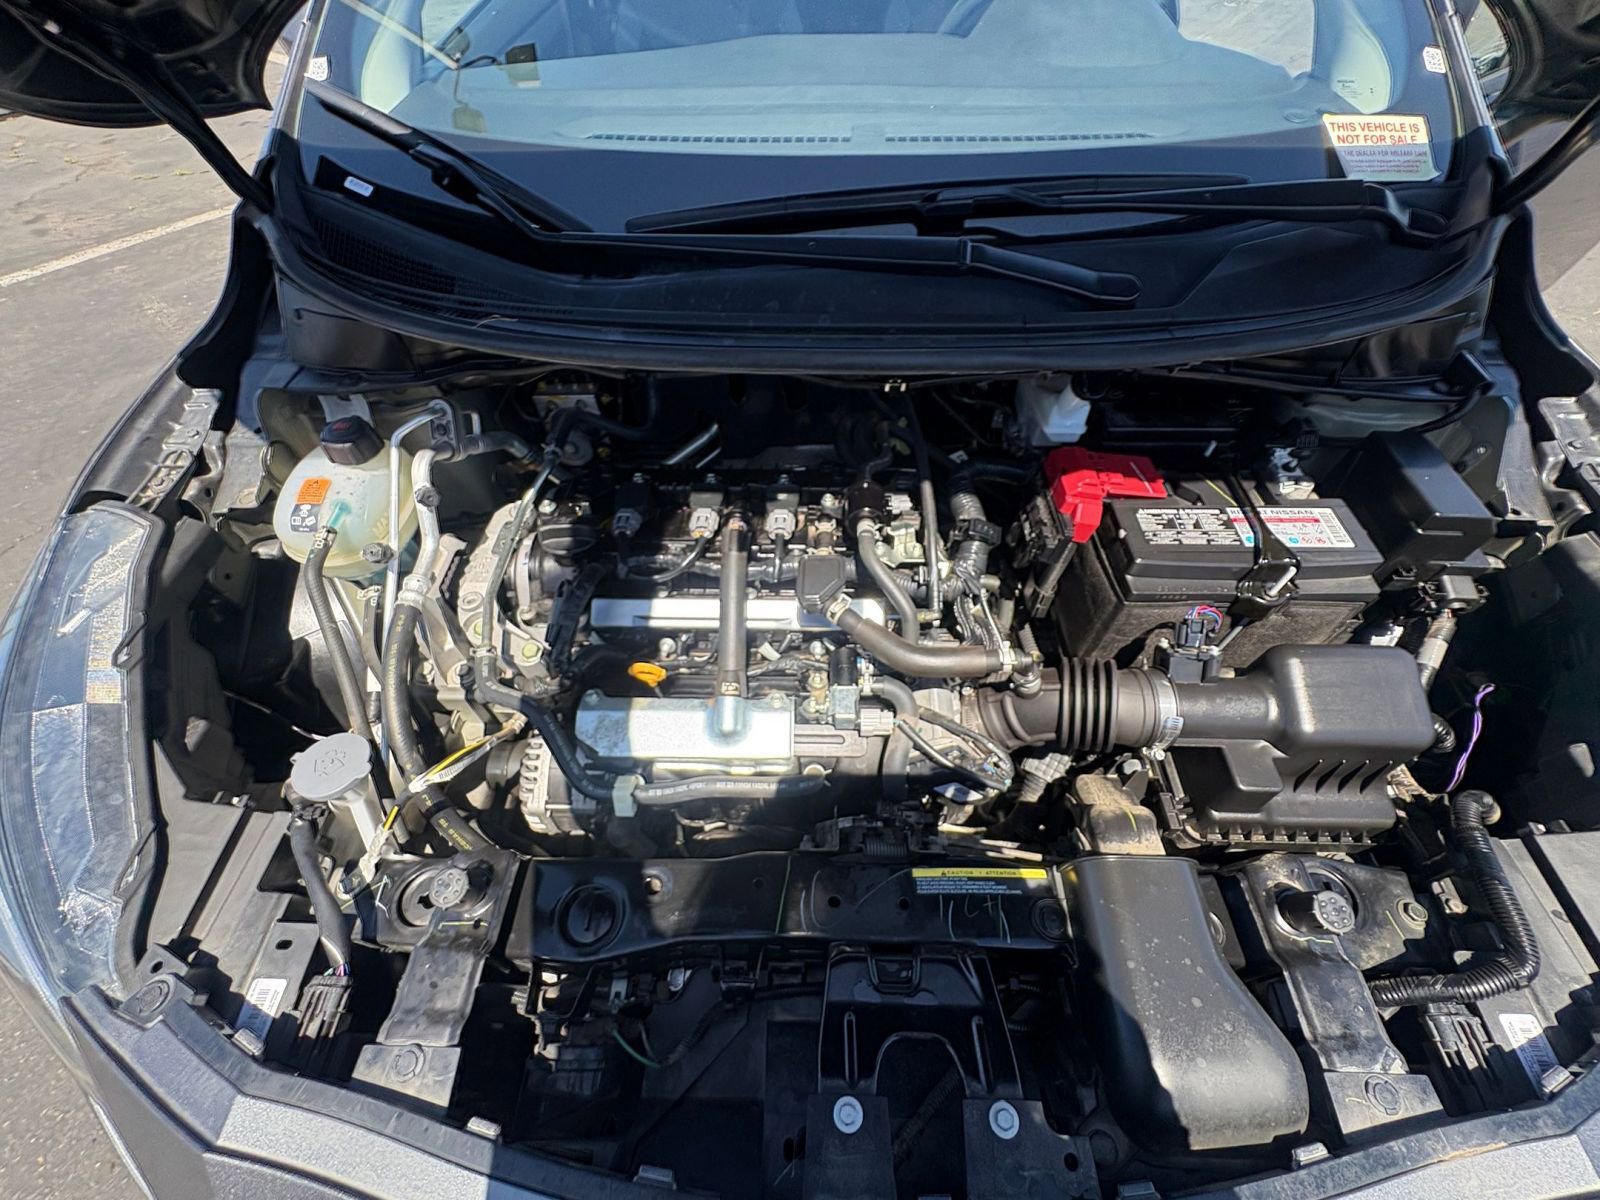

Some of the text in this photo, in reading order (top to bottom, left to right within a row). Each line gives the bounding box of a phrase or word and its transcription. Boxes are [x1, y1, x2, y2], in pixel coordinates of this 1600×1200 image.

[1329, 122, 1420, 133] THIS VEHICLE IS
[1337, 134, 1417, 145] NOT FOR SALE
